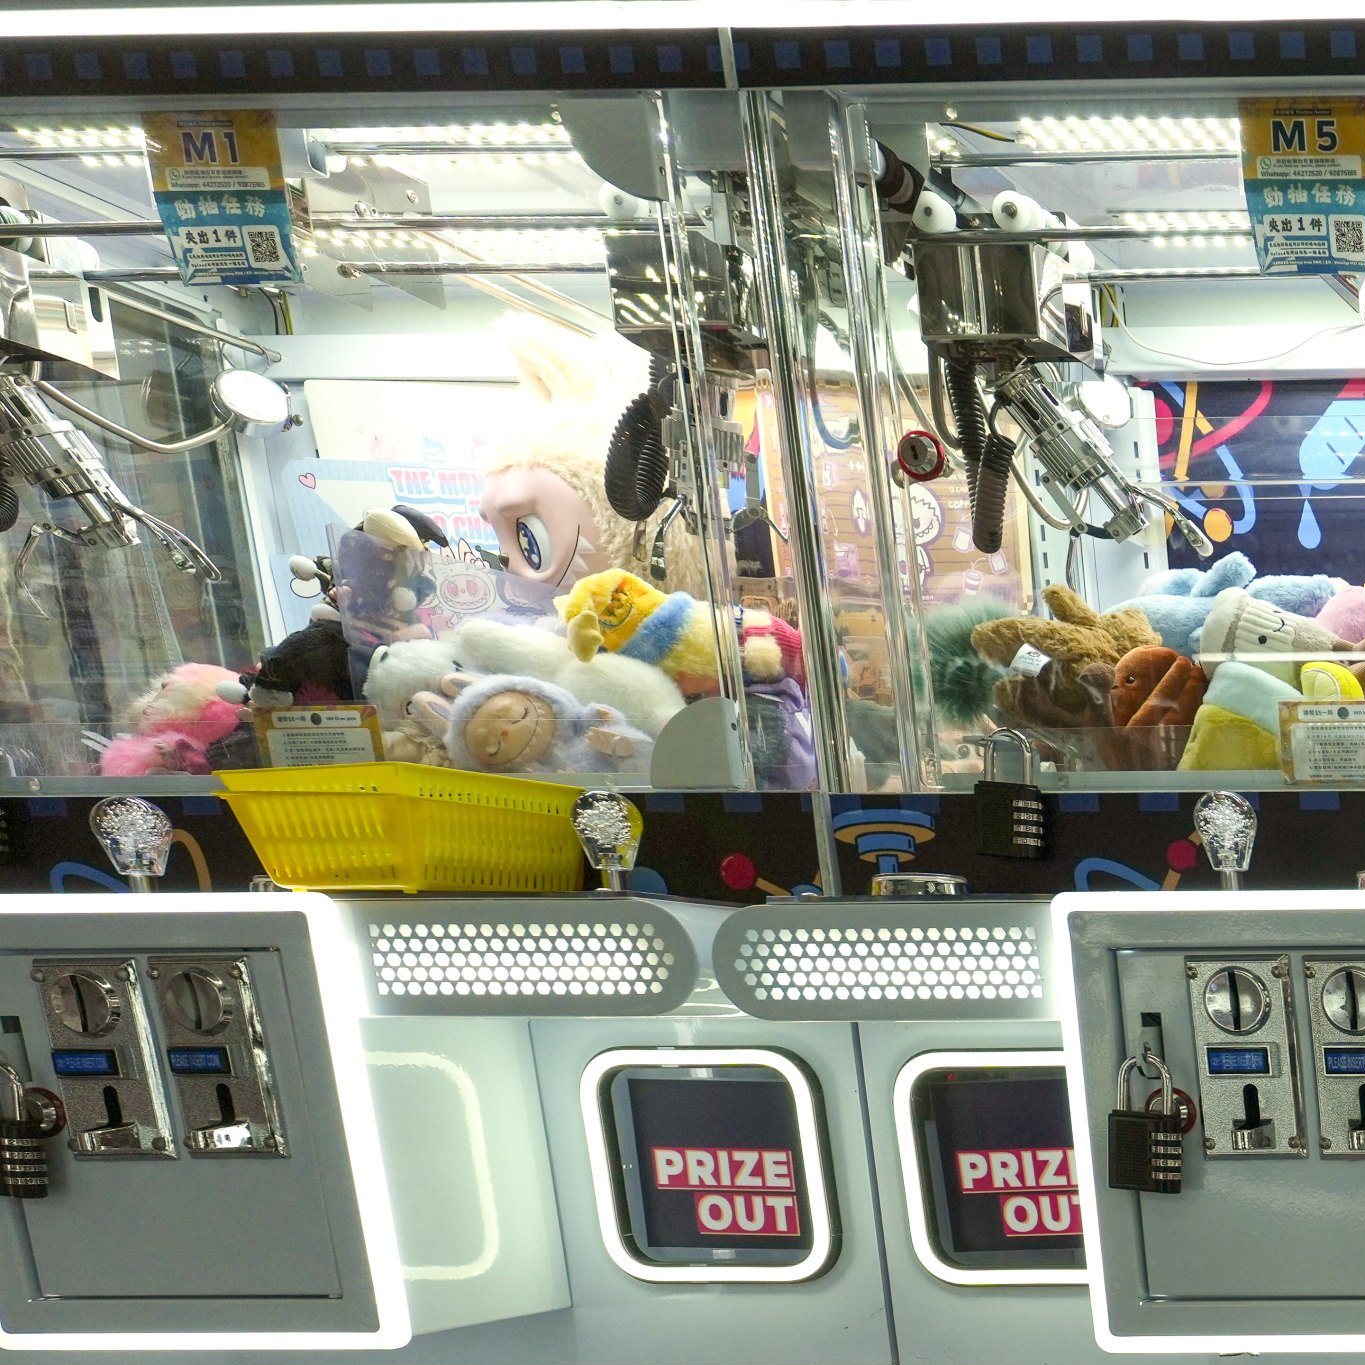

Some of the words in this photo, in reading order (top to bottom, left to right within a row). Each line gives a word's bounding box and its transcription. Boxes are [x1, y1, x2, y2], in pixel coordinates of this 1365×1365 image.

[1260, 170, 1291, 178] Whatsapp:
[389, 469, 433, 495] THE
[654, 1149, 791, 1187] PRIZE
[699, 1195, 793, 1232] OUT
